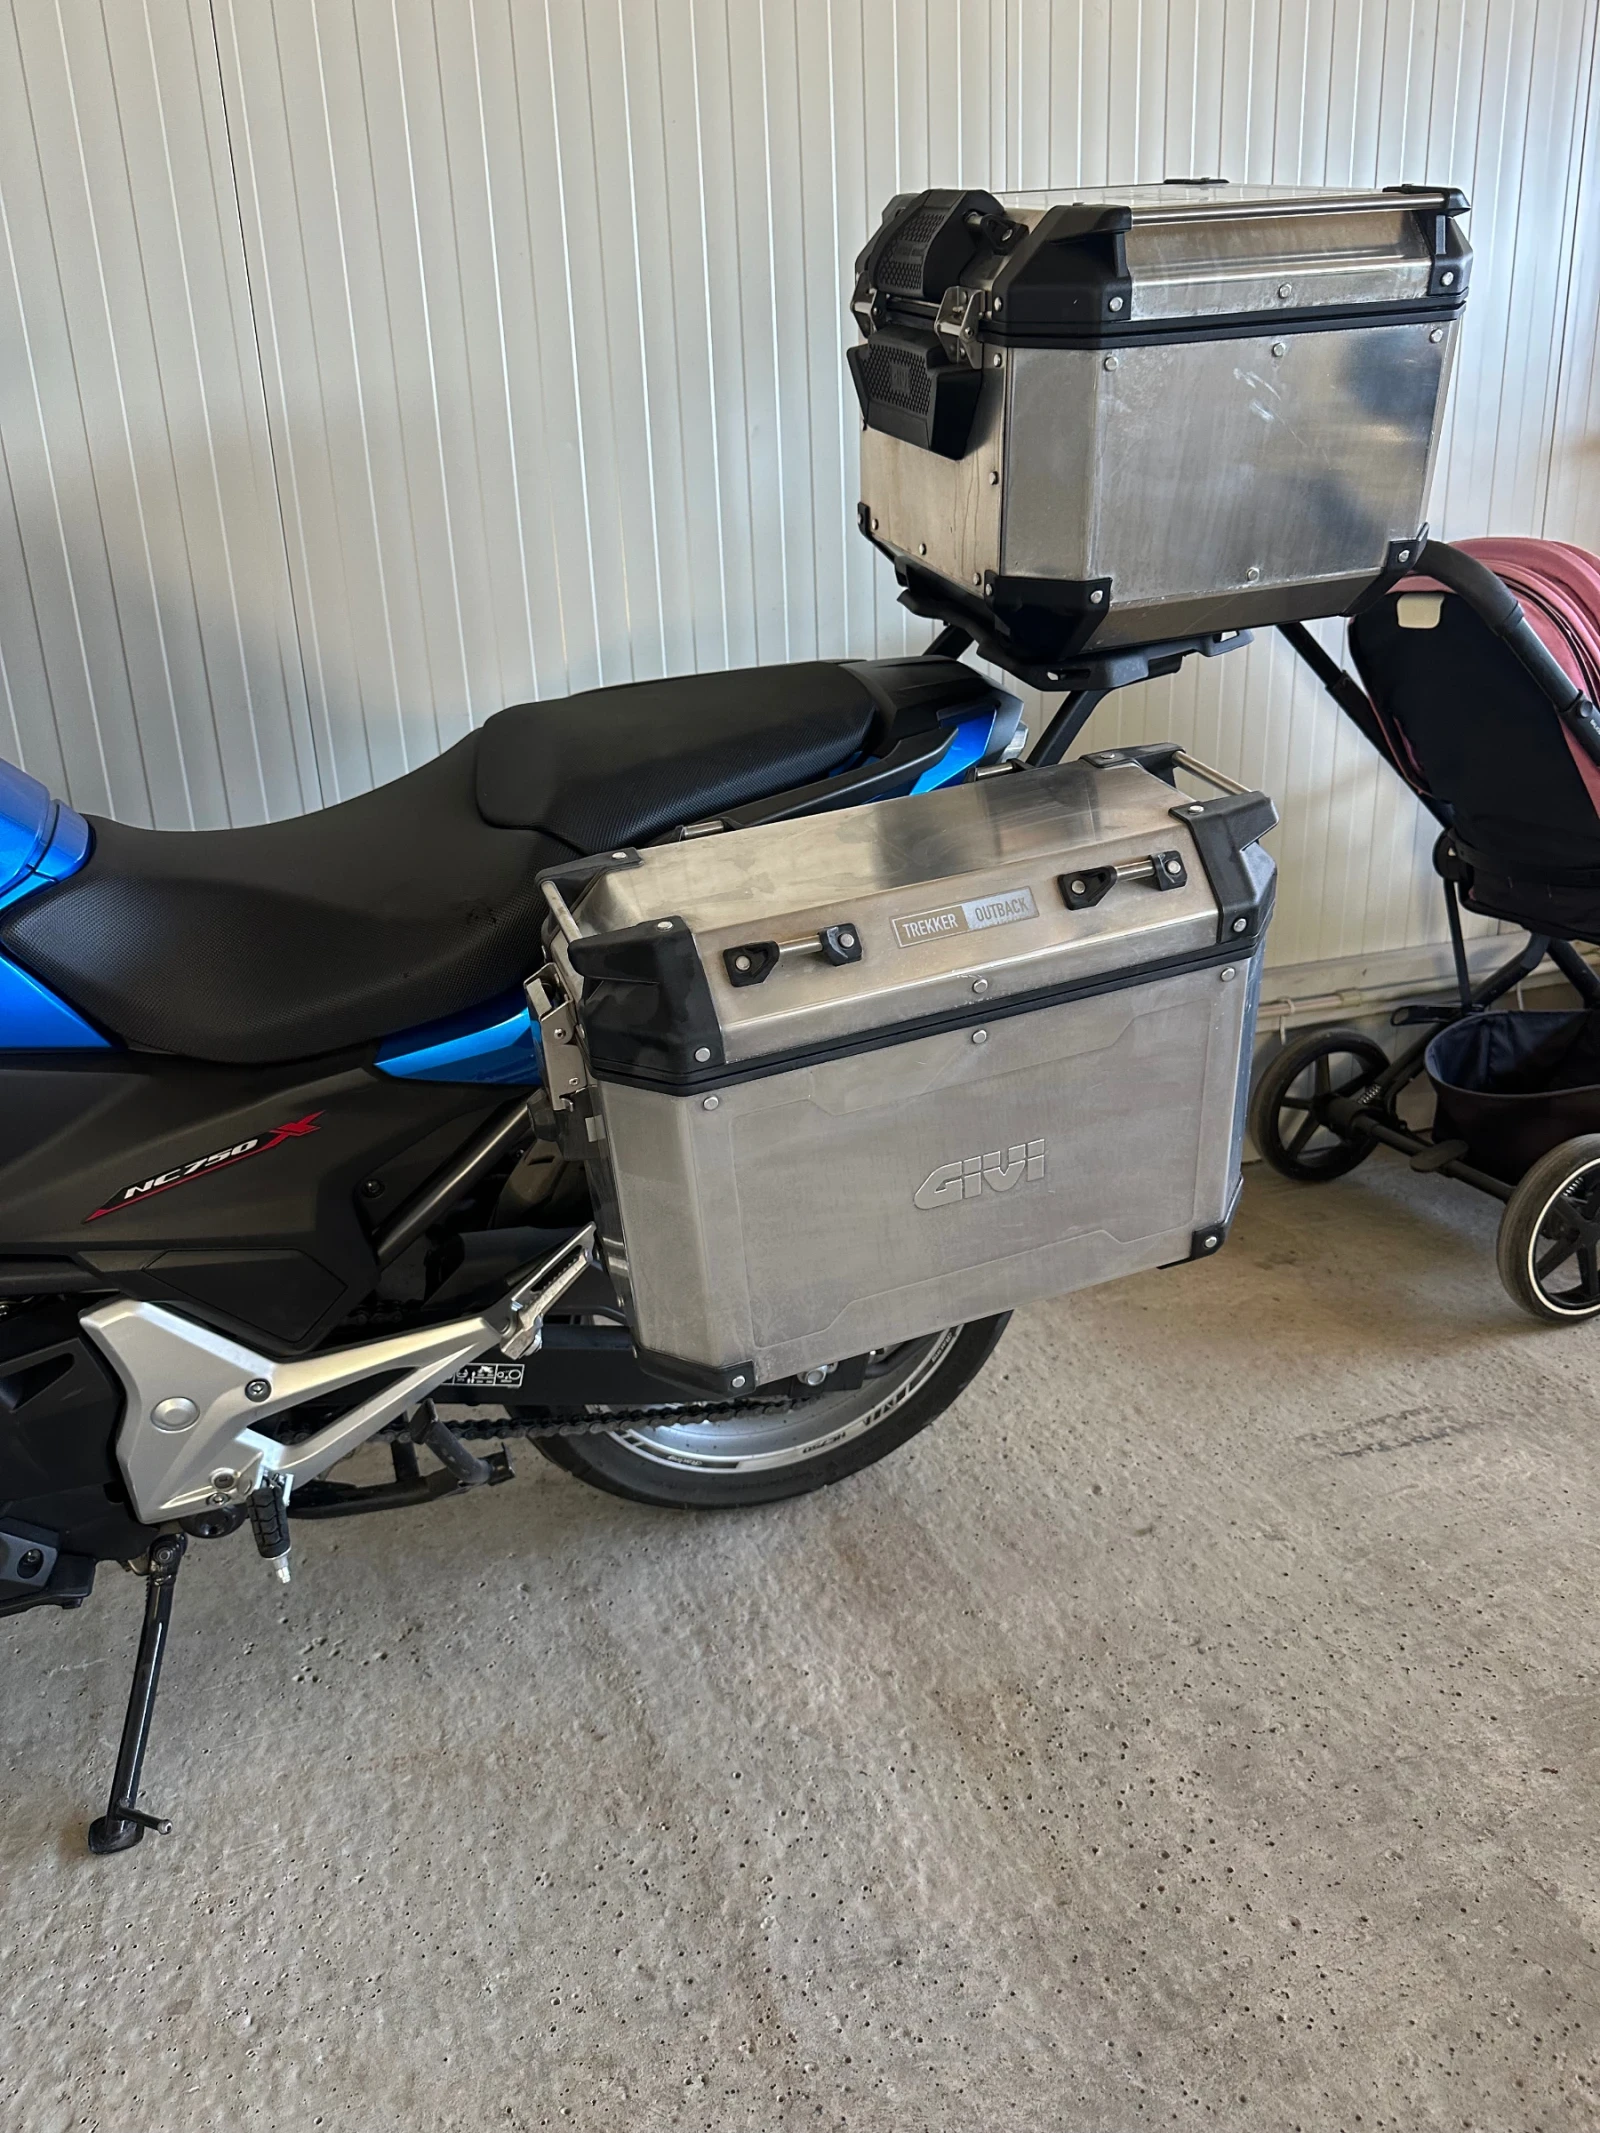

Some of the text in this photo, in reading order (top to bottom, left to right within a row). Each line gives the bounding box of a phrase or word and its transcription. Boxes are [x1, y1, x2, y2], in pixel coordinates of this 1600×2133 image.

[902, 897, 1029, 938] TREKKER OUTBACK
[913, 1138, 1045, 1210] GIVI
